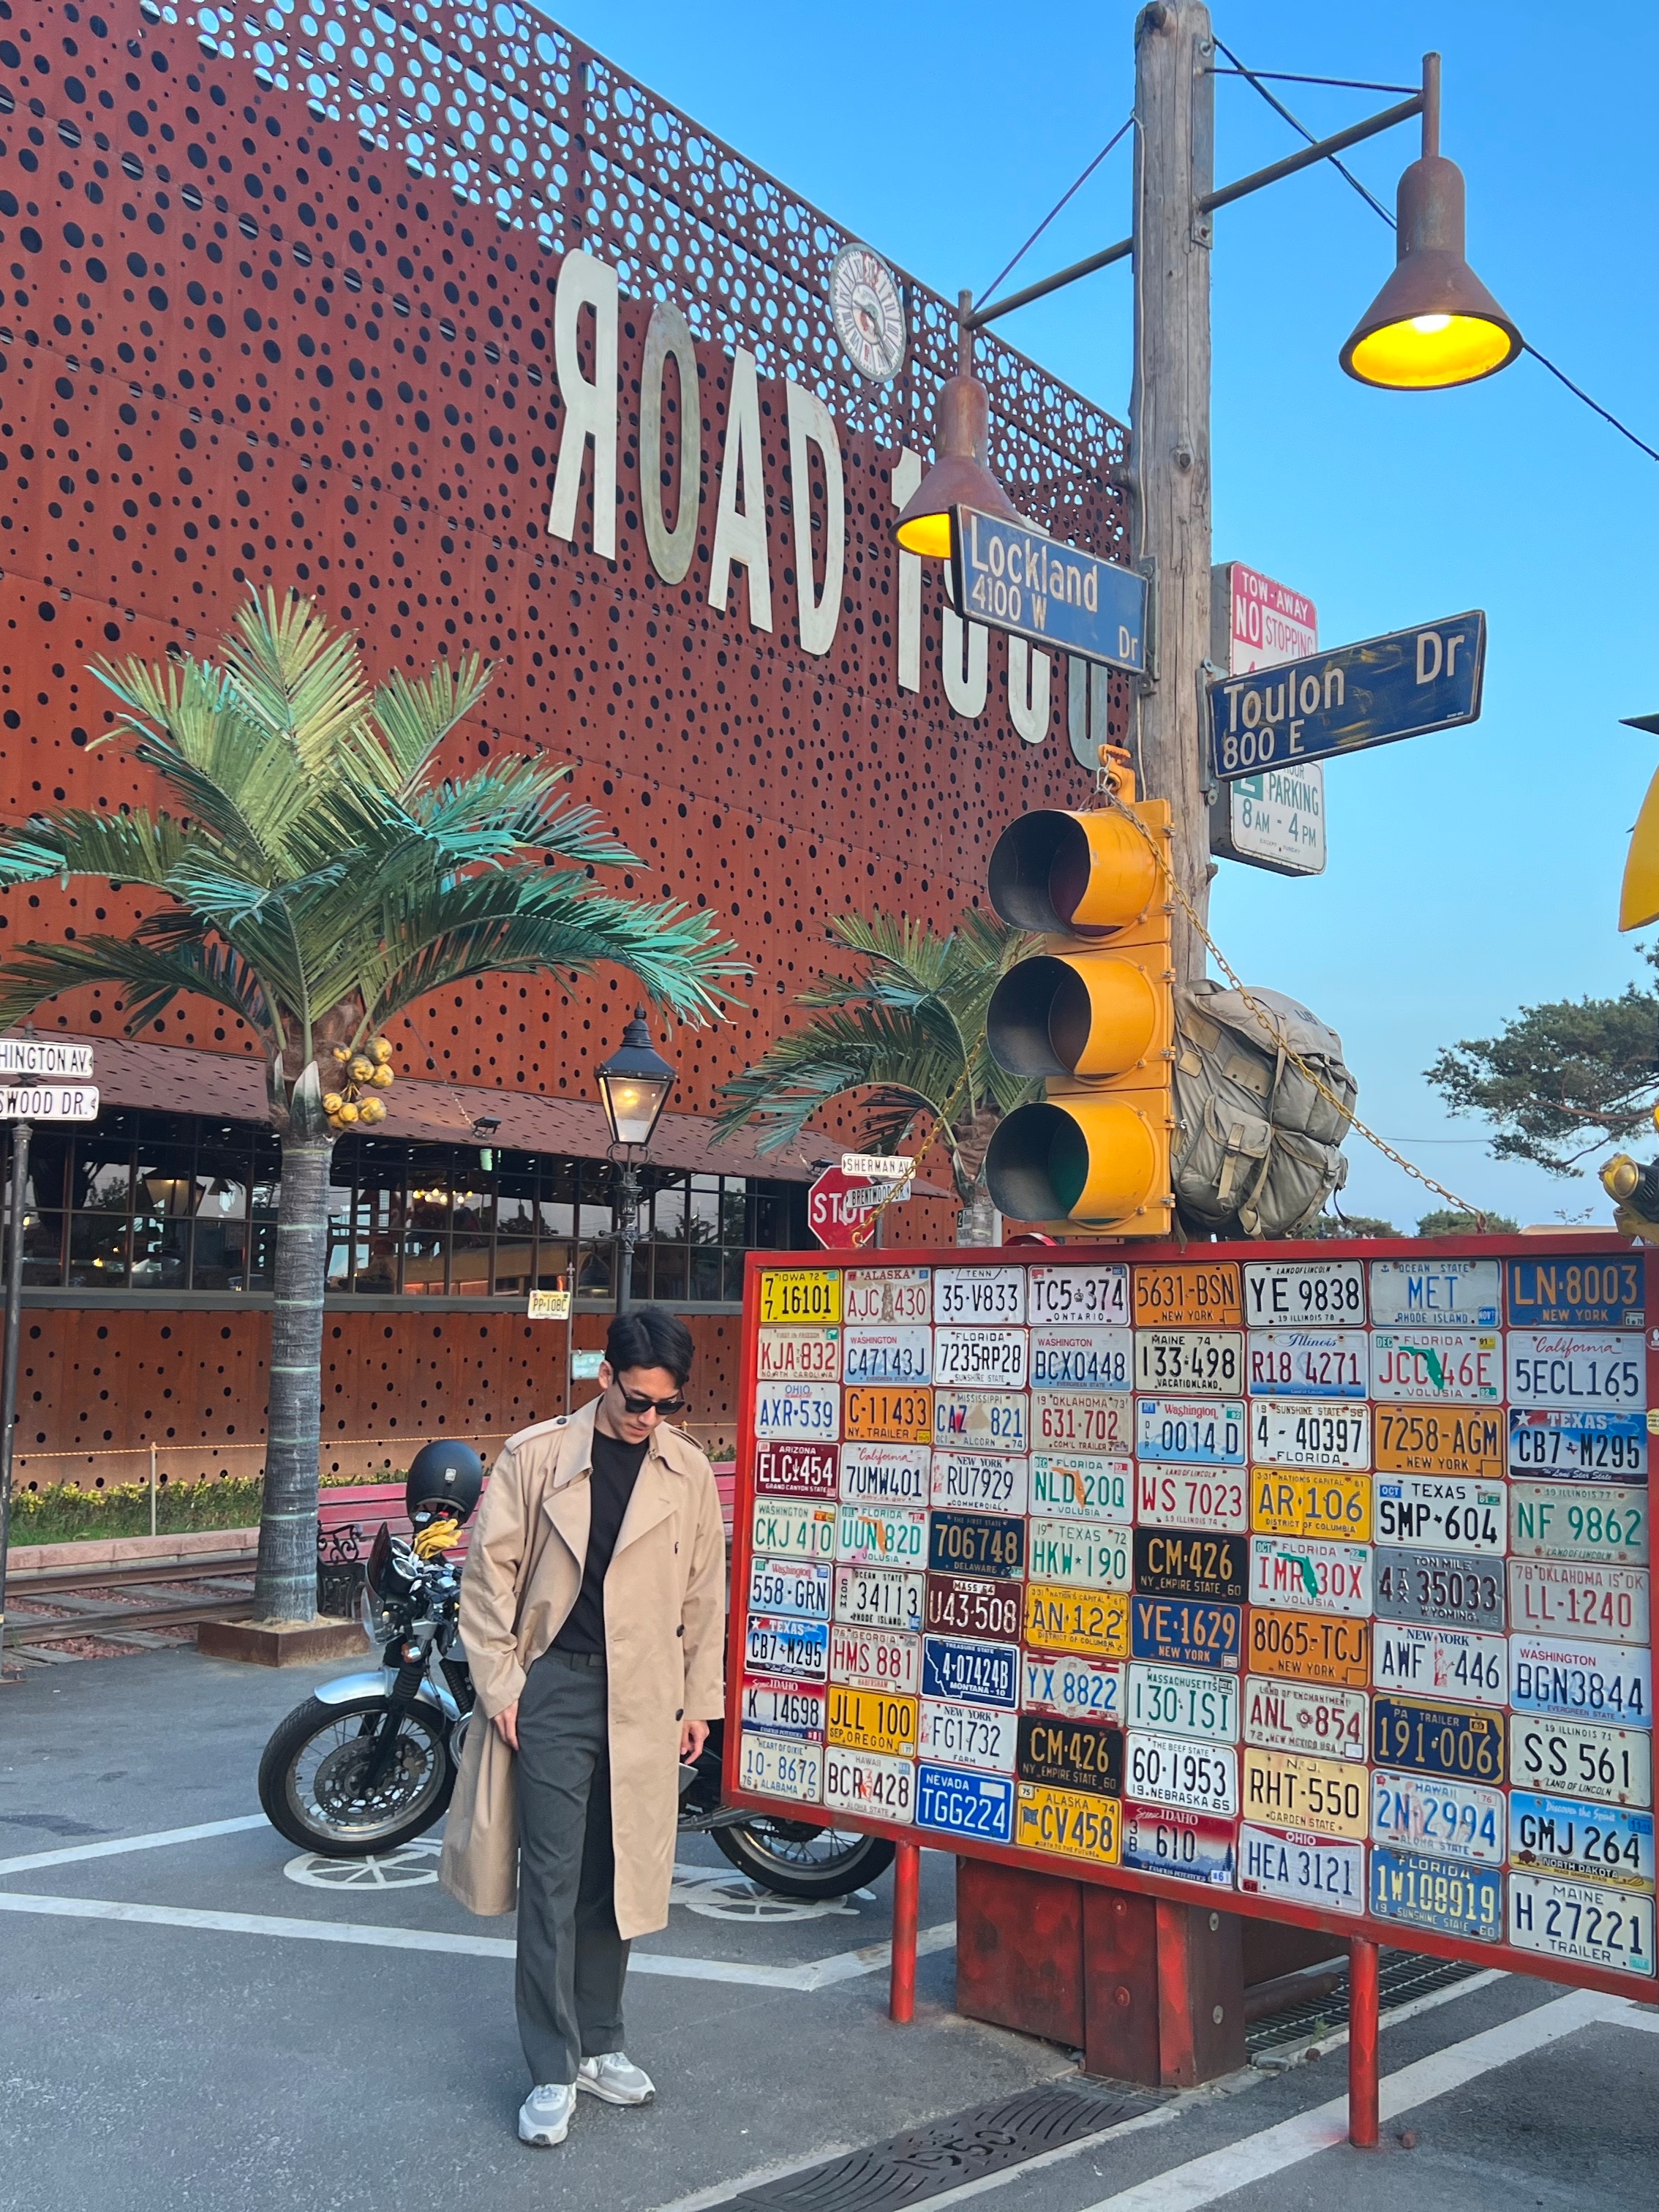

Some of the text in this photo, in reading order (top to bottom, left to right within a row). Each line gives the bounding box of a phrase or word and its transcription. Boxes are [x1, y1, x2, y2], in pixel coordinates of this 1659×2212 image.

[971, 515, 1138, 661] Lockland Dr
[971, 573, 1047, 631] 4100 W
[1235, 595, 1313, 656] NO STOPPING
[1224, 631, 1465, 733] Toulon Dr
[1223, 720, 1304, 770] 800 E
[1268, 773, 1319, 816] PARKING
[1243, 799, 1252, 828] 8
[1255, 814, 1269, 833] AM
[1289, 813, 1298, 842] 4
[1303, 826, 1316, 848] PM
[848, 1159, 895, 1173] SHERMAN
[779, 1273, 805, 1282] IOWA
[864, 1270, 911, 1280] ALASKA
[1399, 1263, 1468, 1273] OCEAN STATE
[782, 1284, 831, 1314] 16101
[848, 1288, 926, 1317] AJC 430
[1250, 1278, 1359, 1312] YE 9838
[1408, 1276, 1458, 1309] MET
[1162, 1309, 1213, 1321] NEW YORK
[1398, 1313, 1467, 1324] RHODE ISLAND
[1543, 1309, 1609, 1321] NEW YORK
[955, 1333, 1004, 1342] FLORIDA
[1536, 1336, 1622, 1358] California
[849, 1348, 924, 1375] C47143J
[1252, 1351, 1361, 1385] R18 4271
[785, 1385, 810, 1393] OHIO
[1516, 1359, 1639, 1396] 5ECL165
[937, 1404, 1023, 1437] CAZ 821
[1547, 1412, 1608, 1429] TEXAS
[859, 1448, 914, 1465] California
[1057, 1459, 1102, 1470] FLORIDA
[1277, 1451, 1341, 1464] FLORIDA
[1407, 1456, 1468, 1470] NEW YORK
[947, 1465, 1014, 1500] RU7929
[1142, 1476, 1242, 1517] WS 7023
[862, 1508, 902, 1519] FLORIDA
[1058, 1506, 1100, 1516] VOLUSIA
[1519, 1502, 1641, 1546] NF 9862
[755, 1518, 832, 1551] CKJ 410
[936, 1524, 1017, 1564] 706748
[772, 1562, 812, 1579] Washington
[857, 1581, 917, 1617] 34113
[1524, 1584, 1631, 1628] LL-1240
[769, 1620, 805, 1635] TEXAS
[834, 1639, 911, 1680] HMS 881
[1158, 1645, 1211, 1662] NEW YORK
[1278, 1660, 1336, 1677] NEW YORK
[1382, 1640, 1500, 1689] AWF 446
[1520, 1648, 1596, 1666] WASHINGTON
[1028, 1666, 1118, 1710] YX 8822
[1148, 1673, 1217, 1692] MASSACHUSETTS
[1517, 1663, 1643, 1715] BGN3844
[749, 1689, 819, 1727] K 14698
[831, 1694, 910, 1737] JLL 100
[944, 1706, 992, 1722] NEW YORK
[932, 1715, 1001, 1757] FG1732
[1524, 1733, 1628, 1788] SS 561
[873, 1772, 908, 1807] 428
[926, 1773, 970, 1791] NEVADA
[922, 1788, 1006, 1834] TGG224
[1162, 1810, 1198, 1826] IDAHO
[1286, 1832, 1316, 1846] OHIO
[1521, 1814, 1639, 1870] GMJ 264
[1249, 1840, 1289, 1883] HEA
[1298, 1850, 1352, 1896] 3121
[1399, 1856, 1471, 1880] FLORIDA
[1554, 1885, 1604, 1906] MAINE
[1516, 1892, 1644, 1955] H 27221
[1549, 1939, 1611, 1963] TRAILER
